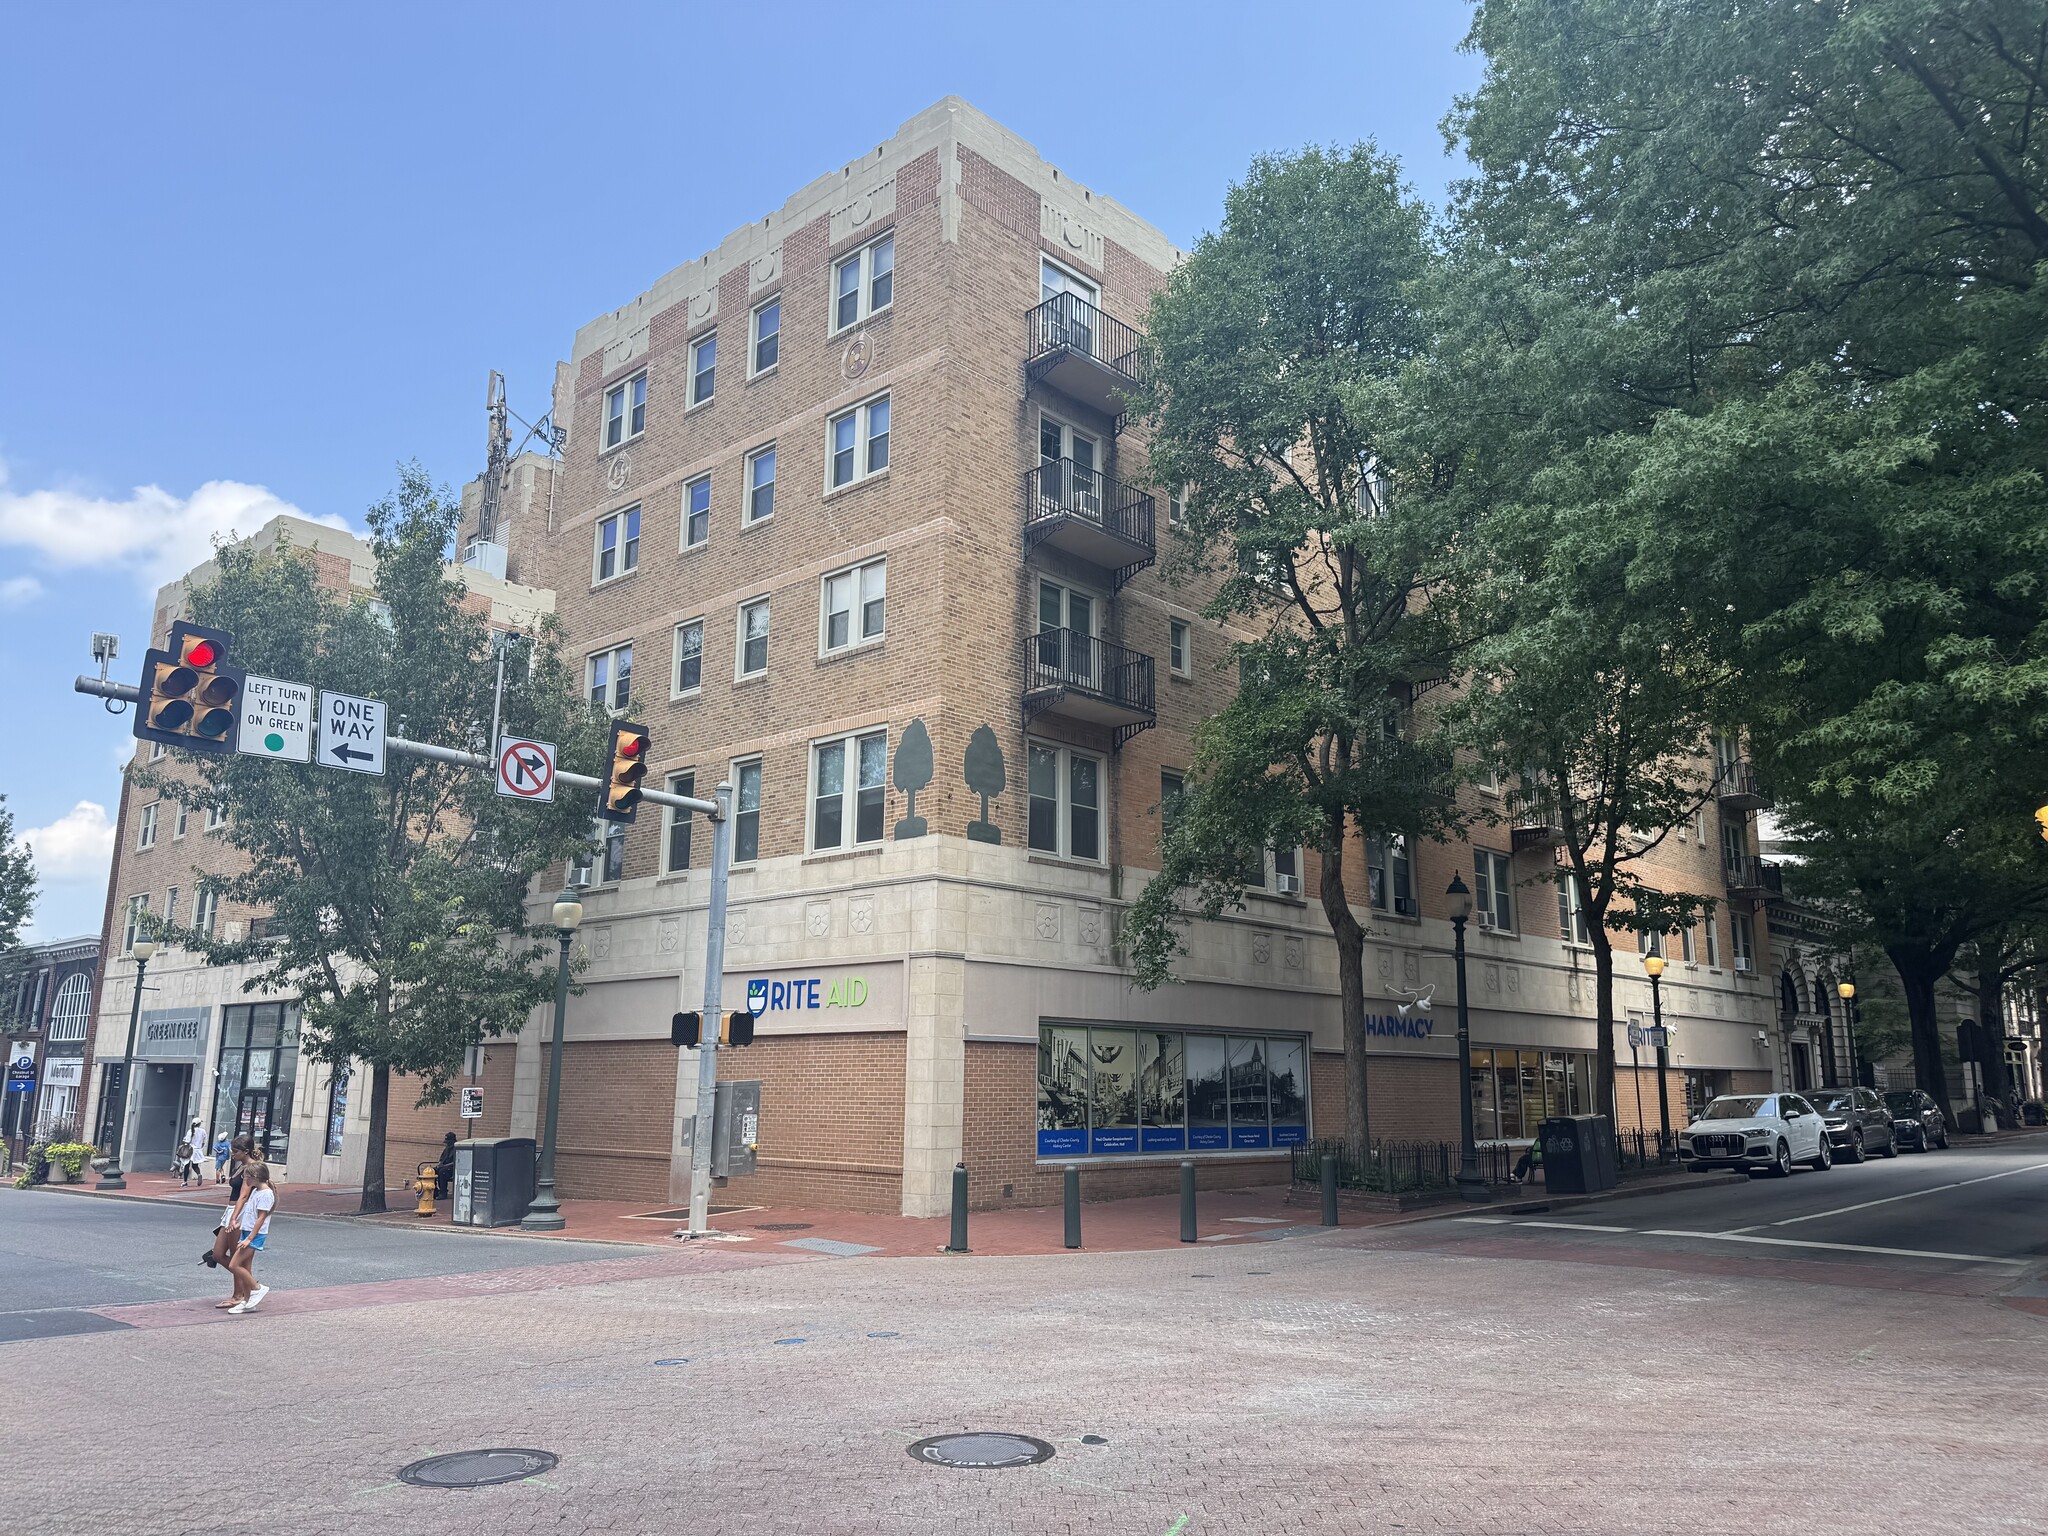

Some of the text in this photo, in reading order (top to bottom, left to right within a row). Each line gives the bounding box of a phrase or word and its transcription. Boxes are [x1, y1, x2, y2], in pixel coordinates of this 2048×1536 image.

[248, 682, 307, 702] LEFT TURN
[258, 698, 296, 716] YIELD
[333, 699, 375, 722] ONE
[247, 714, 304, 733] ON GREEN
[330, 718, 375, 741] WAY
[770, 976, 869, 1011] RITE AID
[147, 1020, 199, 1041] GREENTREE
[1363, 1013, 1434, 1039] HARMACY
